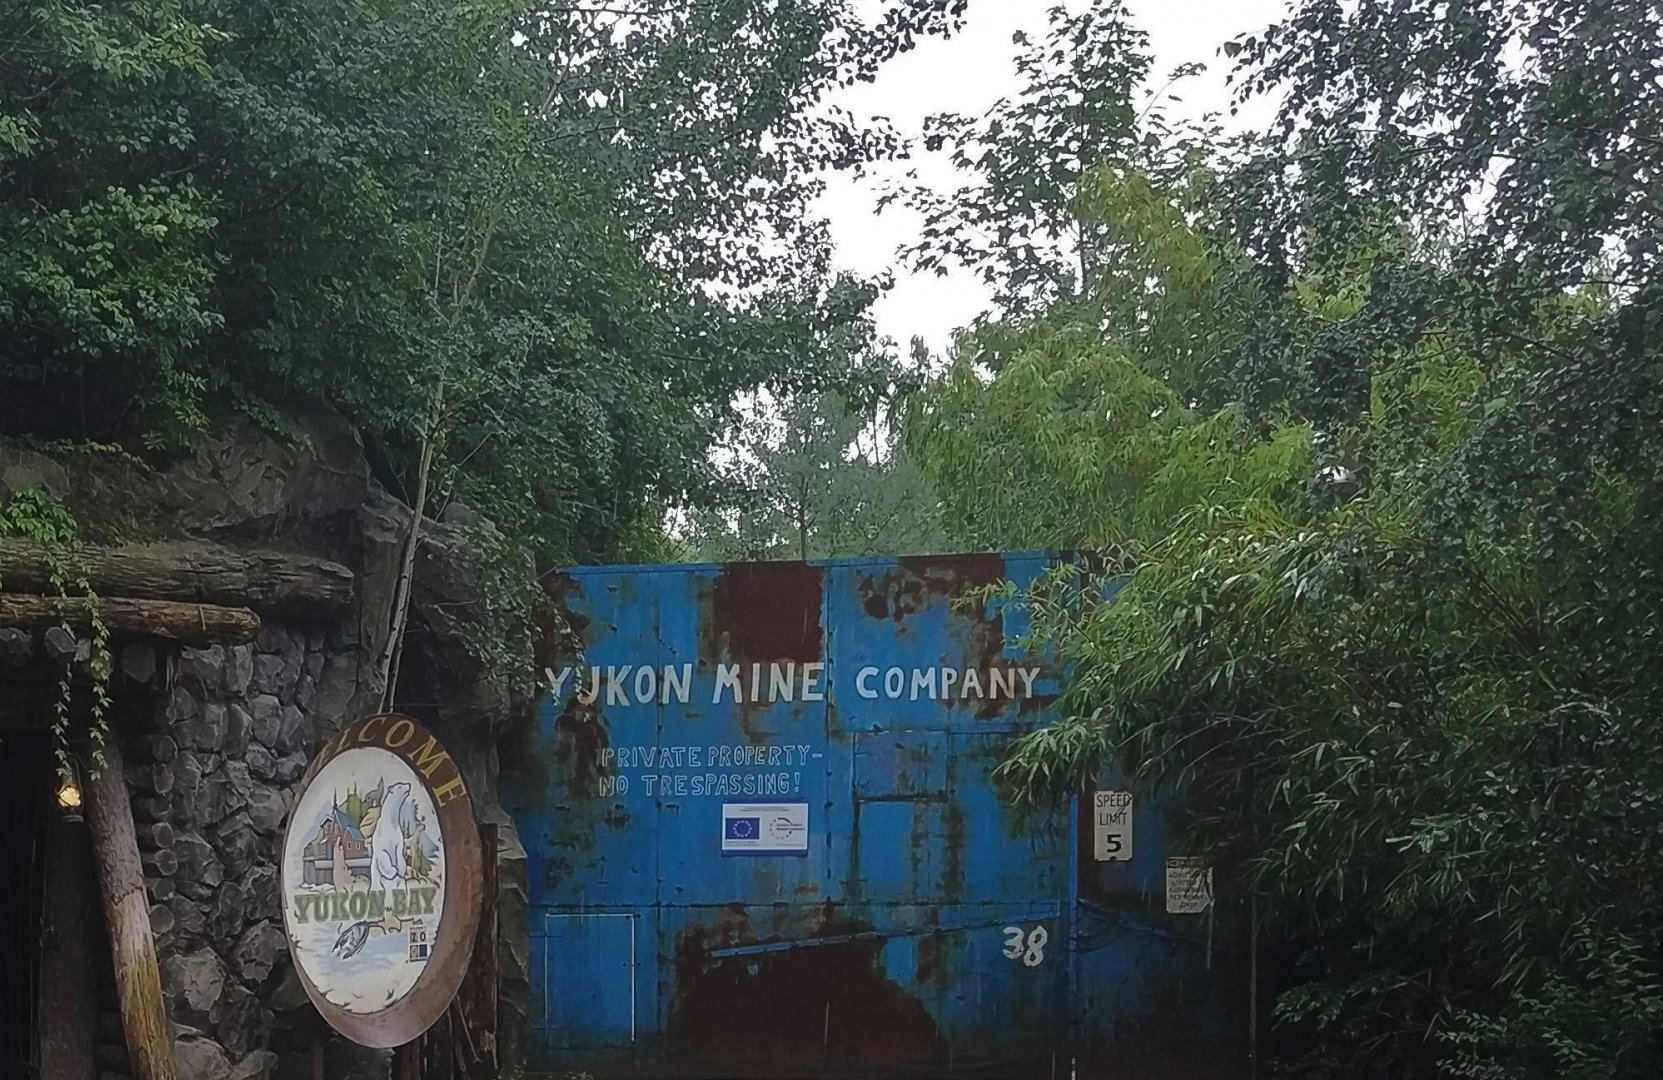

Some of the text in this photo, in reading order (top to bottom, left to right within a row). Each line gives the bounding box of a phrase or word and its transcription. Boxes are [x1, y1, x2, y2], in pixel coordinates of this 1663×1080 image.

[713, 662, 825, 704] MINE
[856, 666, 1041, 700] COMPANY
[600, 746, 702, 769] PRIVATE
[599, 772, 801, 797] NO TRESPASSING!
[1096, 794, 1131, 808] SPEED
[1099, 812, 1128, 826] LIMIT
[1106, 834, 1122, 853] 5
[294, 887, 437, 924] YUKON BAY
[1002, 925, 1048, 967] 38
